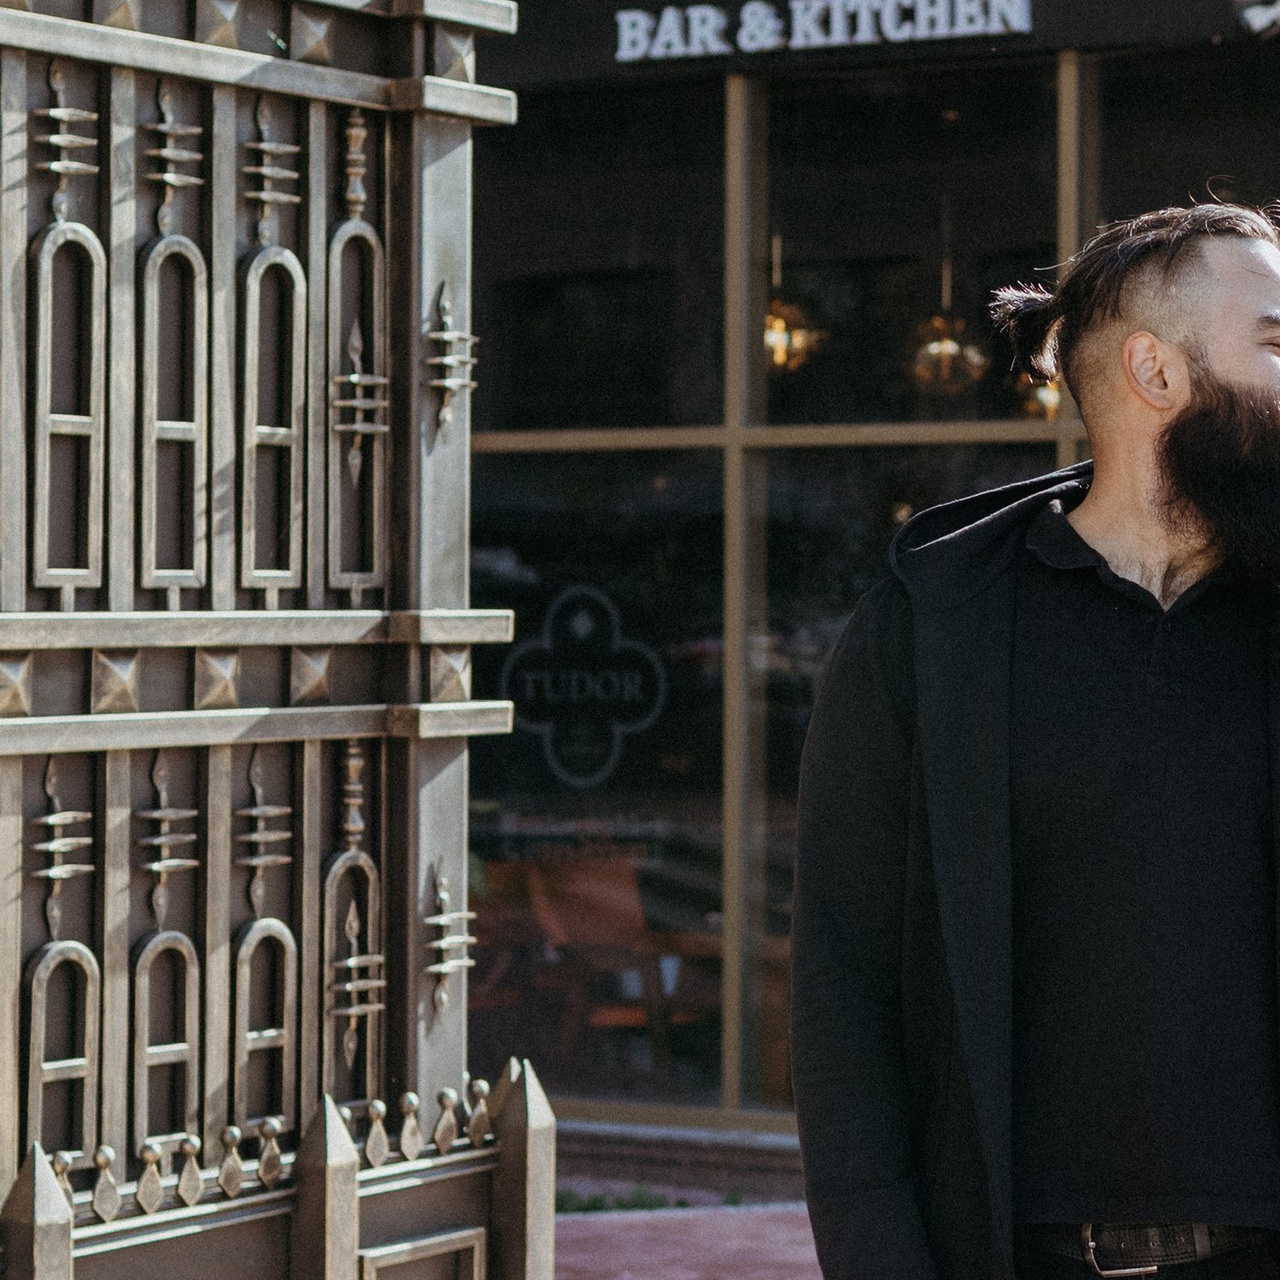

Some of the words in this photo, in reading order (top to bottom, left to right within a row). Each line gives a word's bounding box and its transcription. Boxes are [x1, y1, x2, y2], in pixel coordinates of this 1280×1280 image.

[614, 4, 733, 63] BAR
[737, 0, 785, 54] &
[518, 669, 645, 703] TUDOR
